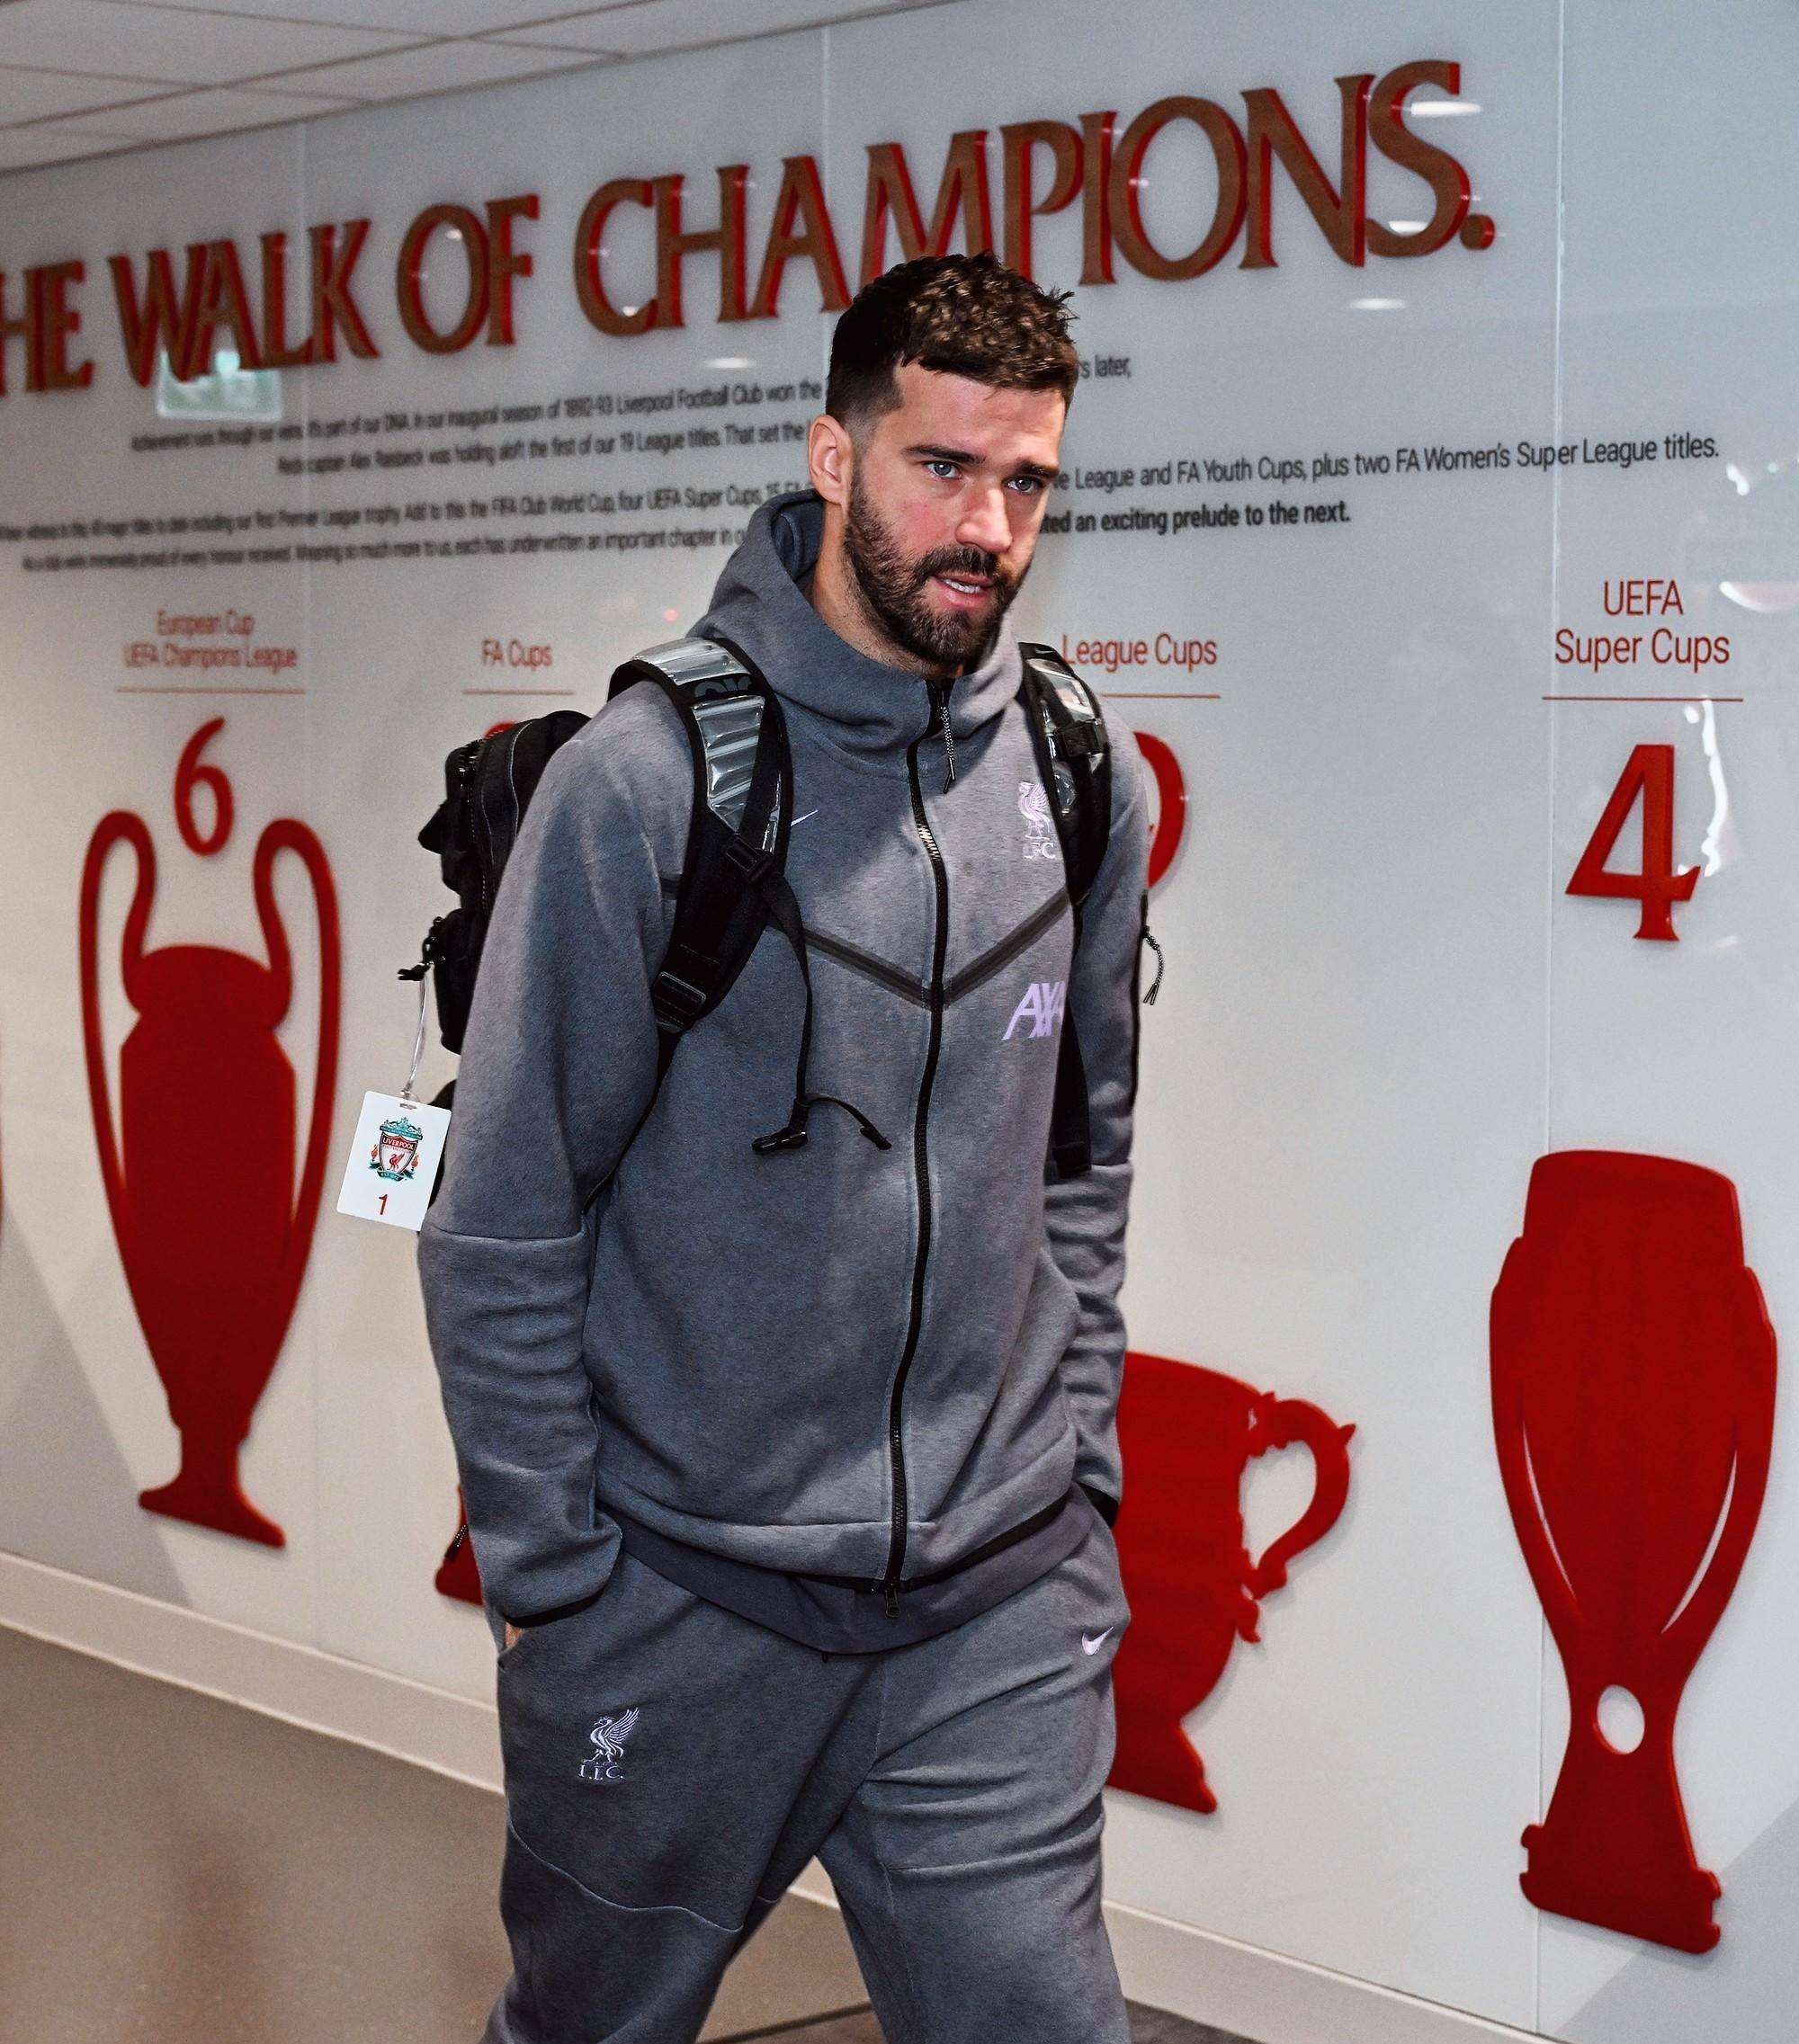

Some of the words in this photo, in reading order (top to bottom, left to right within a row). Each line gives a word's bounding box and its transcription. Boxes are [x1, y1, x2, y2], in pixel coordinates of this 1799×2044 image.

[107, 218, 381, 388] WALK
[396, 194, 540, 354] OF
[616, 392, 675, 415] Liverpool
[677, 386, 729, 408] Football
[732, 385, 763, 406] Club
[765, 385, 795, 402] won
[799, 379, 822, 399] the
[1095, 355, 1132, 379] later,
[637, 433, 685, 453] League
[648, 487, 682, 510] UEFA
[685, 487, 723, 510] Super
[1076, 466, 1134, 494] League
[1140, 461, 1171, 486] and
[1177, 460, 1201, 484] FA
[1204, 457, 1252, 483] Youth
[1258, 455, 1308, 485] Cups,
[1311, 452, 1349, 483] plus
[1356, 452, 1390, 476] two
[1396, 448, 1420, 473] FA
[1424, 442, 1511, 472] Women's
[1517, 441, 1579, 473] Super
[1582, 437, 1658, 469] League
[1664, 432, 1720, 460] titles.
[1075, 513, 1096, 533] an
[1101, 506, 1168, 537] exciting
[1172, 504, 1240, 537] prelude
[1245, 504, 1264, 527] to
[1268, 501, 1299, 525] the
[1304, 501, 1351, 524] next.
[1604, 580, 1685, 616] UEFA
[481, 639, 504, 666] FA
[508, 638, 554, 671] Cups
[1062, 633, 1147, 675] League
[1154, 632, 1218, 674] Cups
[1554, 628, 1642, 673] Super
[1651, 628, 1732, 673] Cups
[175, 716, 234, 857] 6
[1564, 743, 1701, 942] 4
[382, 1136, 415, 1150] LIVERPOOL
[378, 1193, 389, 1215] 1
